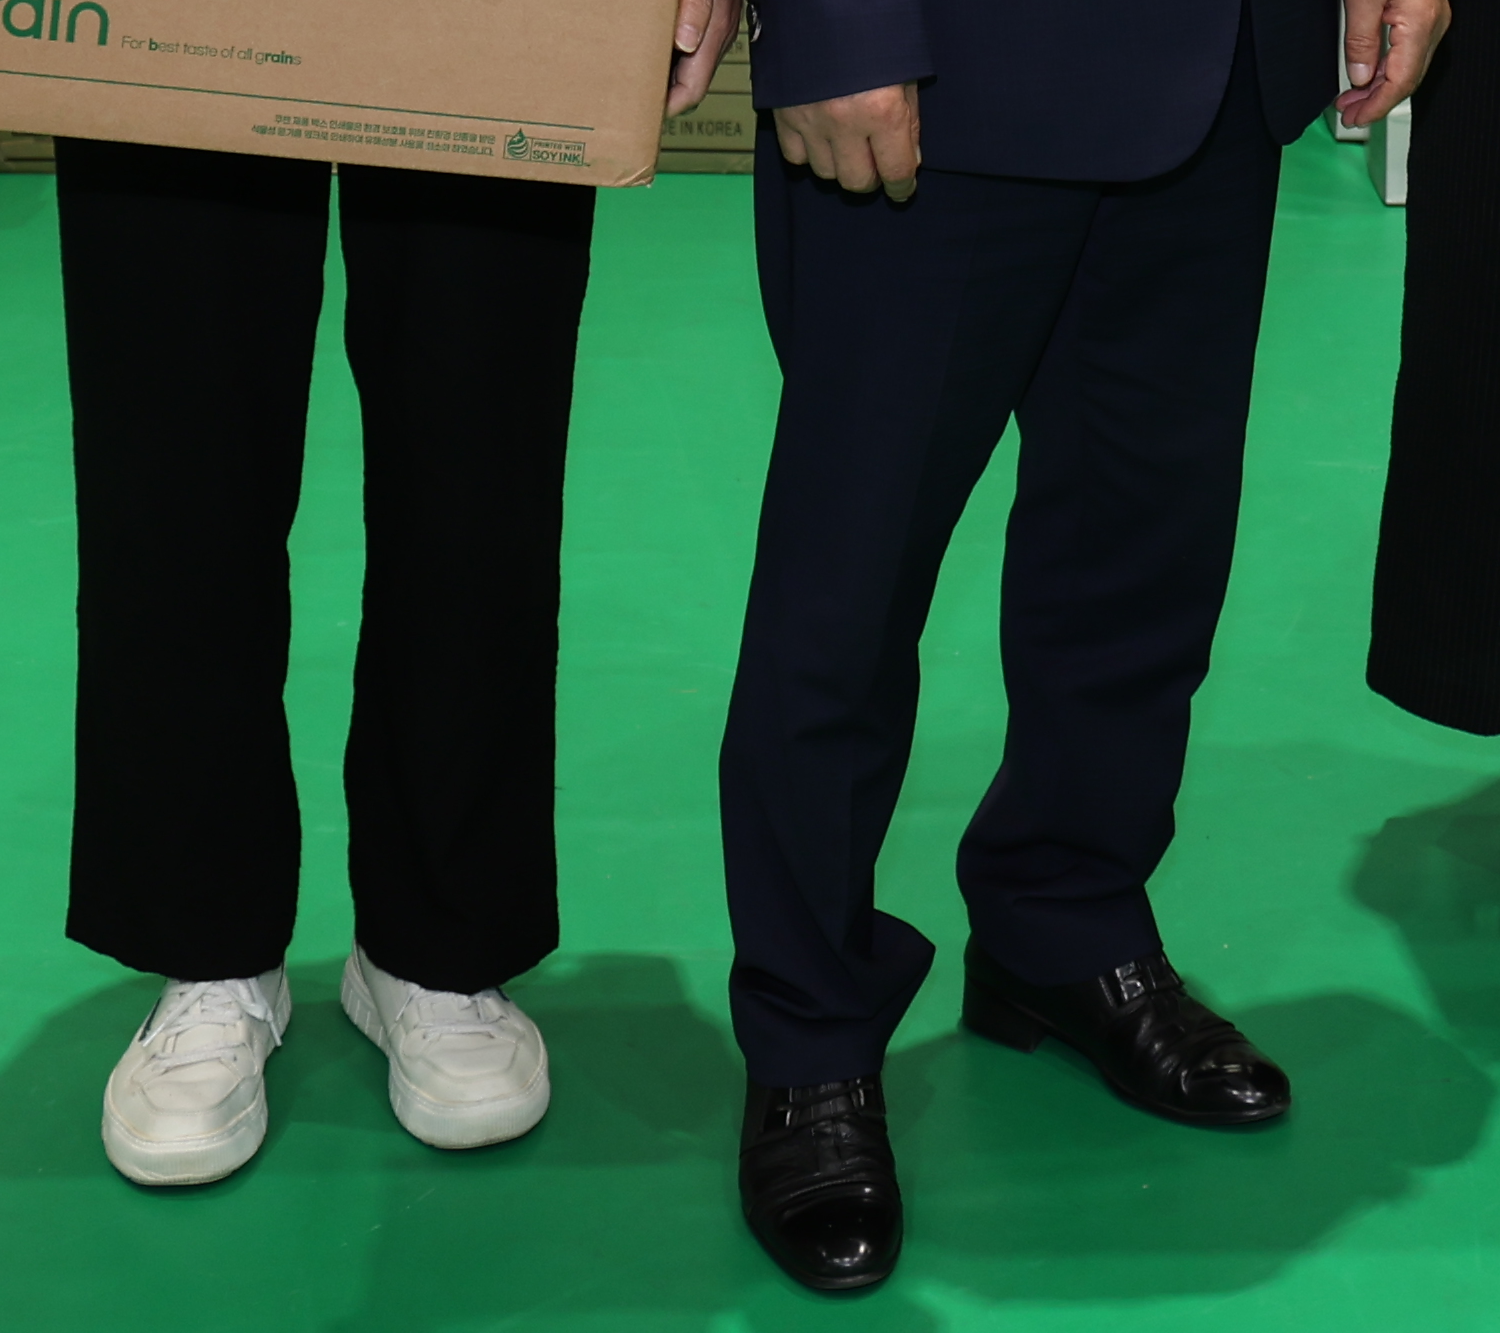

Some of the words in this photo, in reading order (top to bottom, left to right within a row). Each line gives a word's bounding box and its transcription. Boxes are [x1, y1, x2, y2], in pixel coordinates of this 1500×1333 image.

[121, 35, 146, 50] For
[148, 38, 180, 54] best
[183, 42, 218, 58] taste
[220, 46, 234, 59] of
[237, 48, 253, 61] all
[255, 50, 302, 66] grains
[698, 121, 743, 136] KOREA
